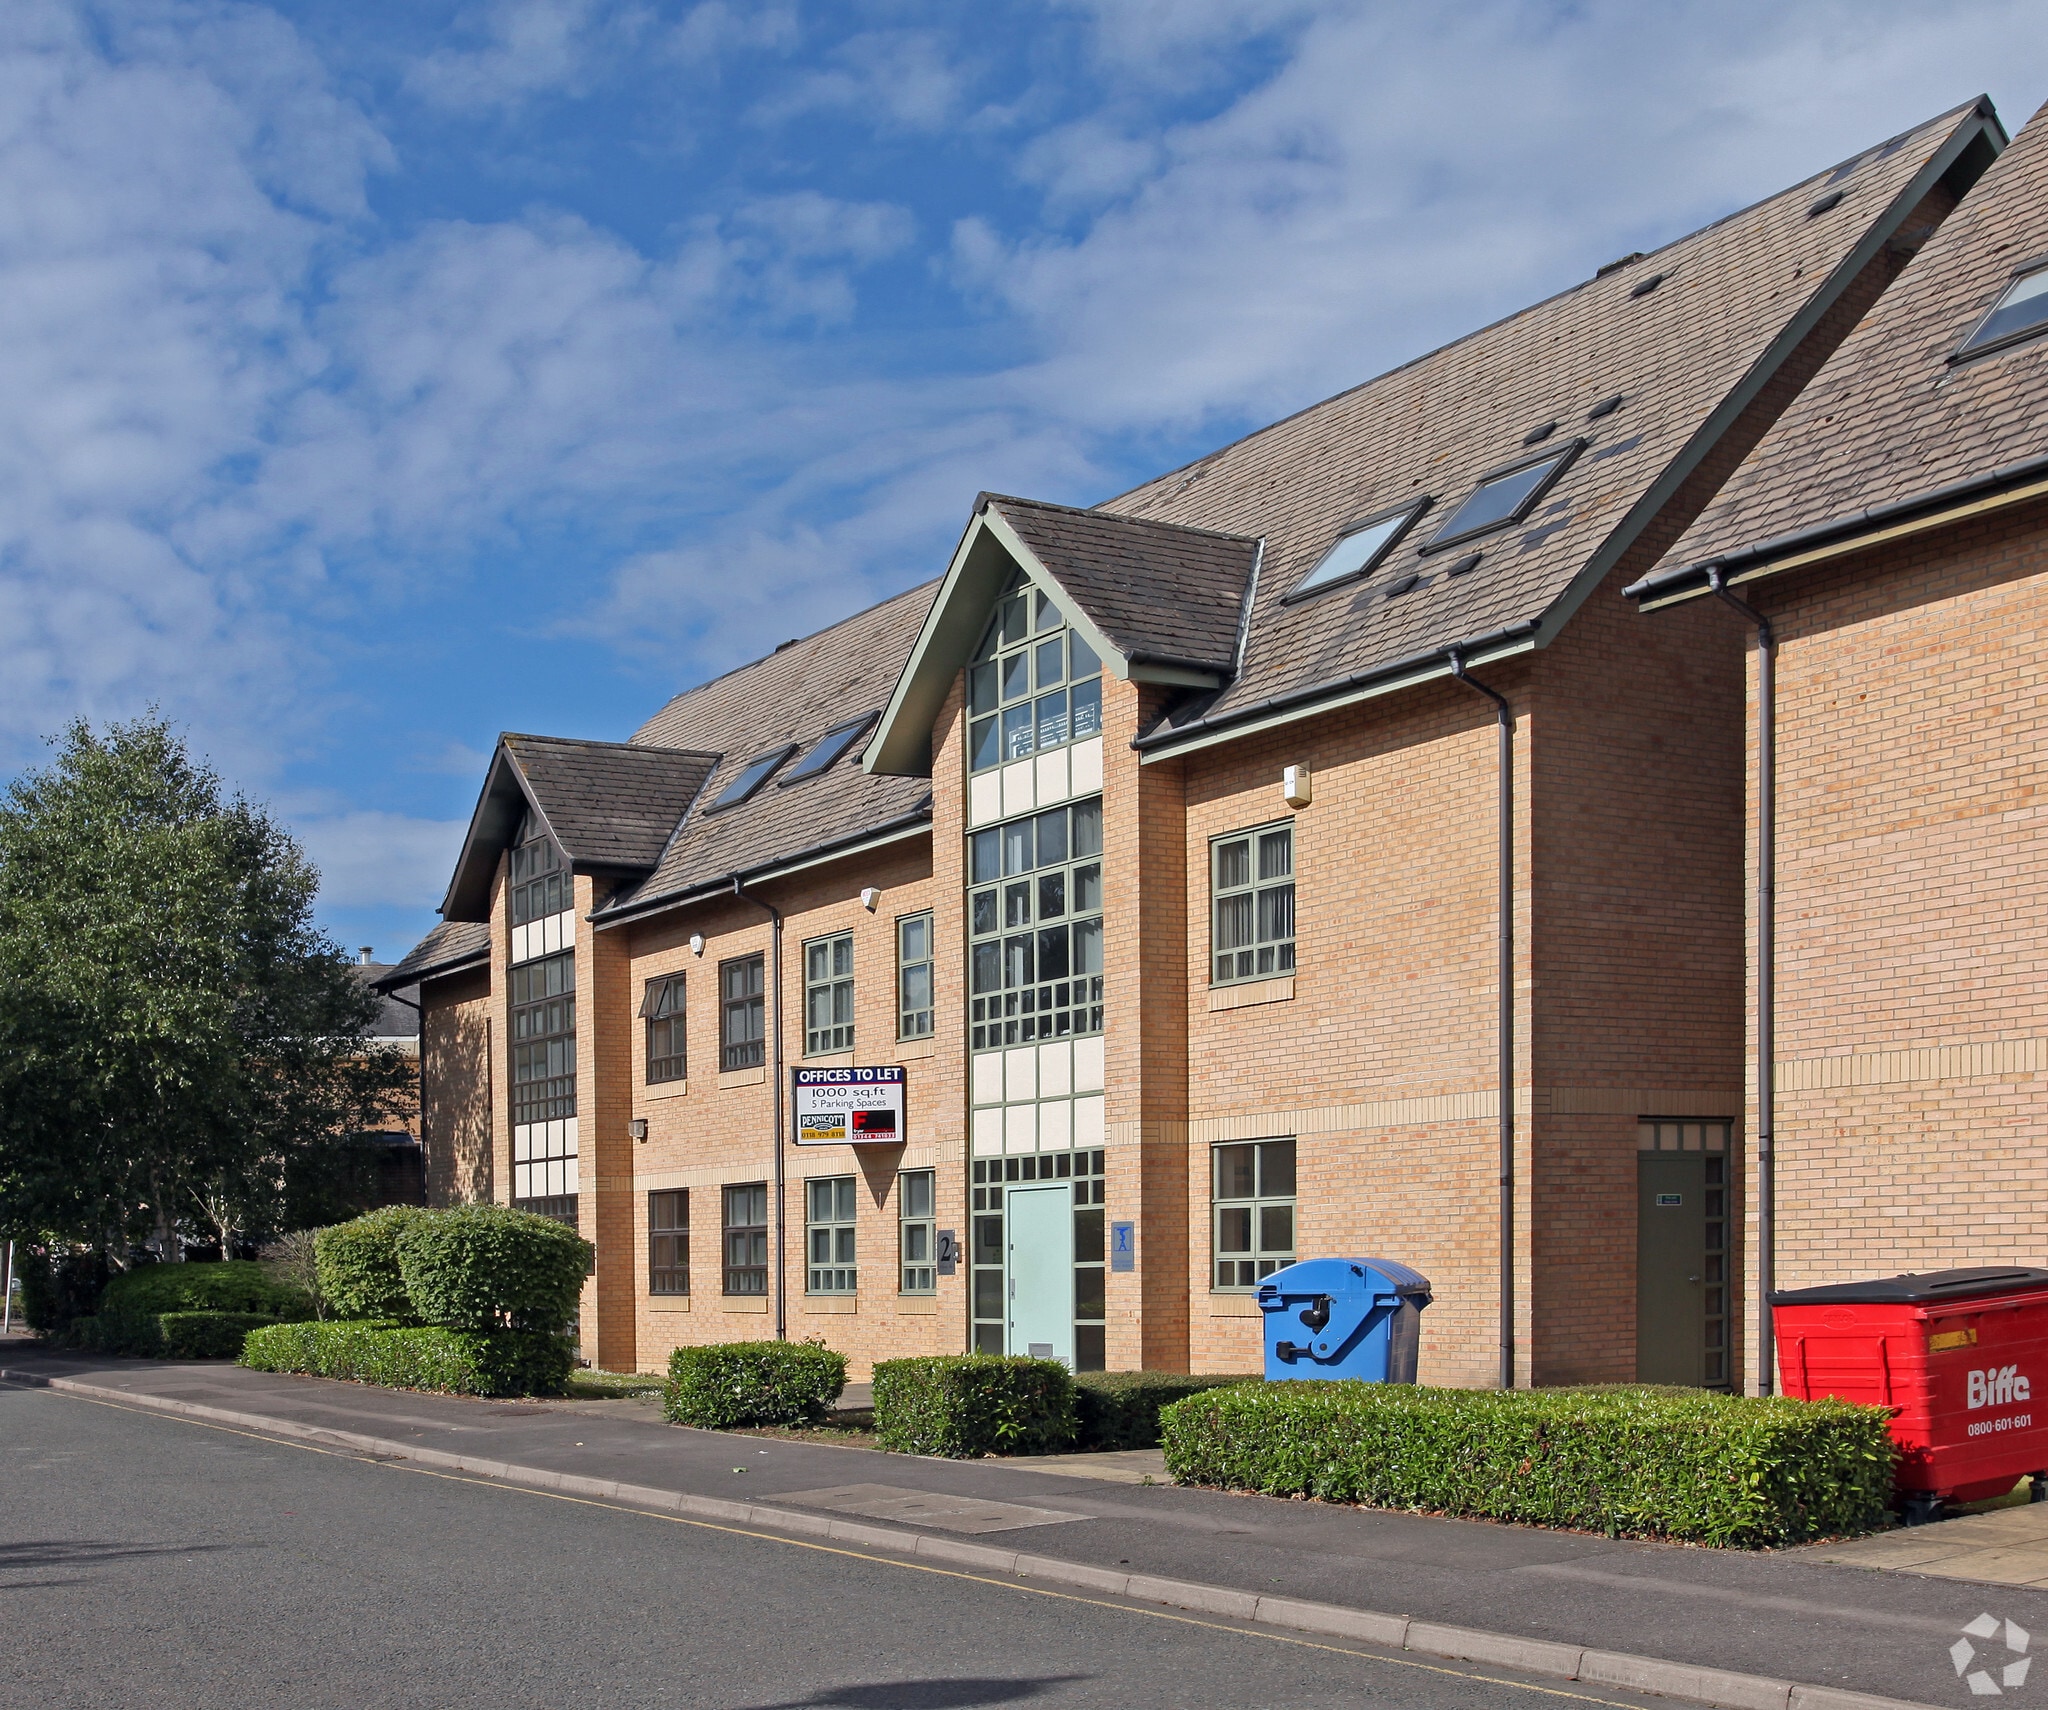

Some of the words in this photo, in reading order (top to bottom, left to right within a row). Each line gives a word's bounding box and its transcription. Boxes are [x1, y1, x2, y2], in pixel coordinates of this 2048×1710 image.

[799, 1069, 851, 1083] OFFICES
[854, 1068, 873, 1081] TO
[877, 1067, 901, 1080] LET
[812, 1088, 847, 1097] 1000
[853, 1086, 886, 1098] sq.ft
[812, 1100, 817, 1108] 5
[820, 1099, 854, 1109] Parking
[856, 1098, 887, 1108] Spaces
[802, 1115, 844, 1127] PENNICOTT
[940, 1236, 951, 1262] 2
